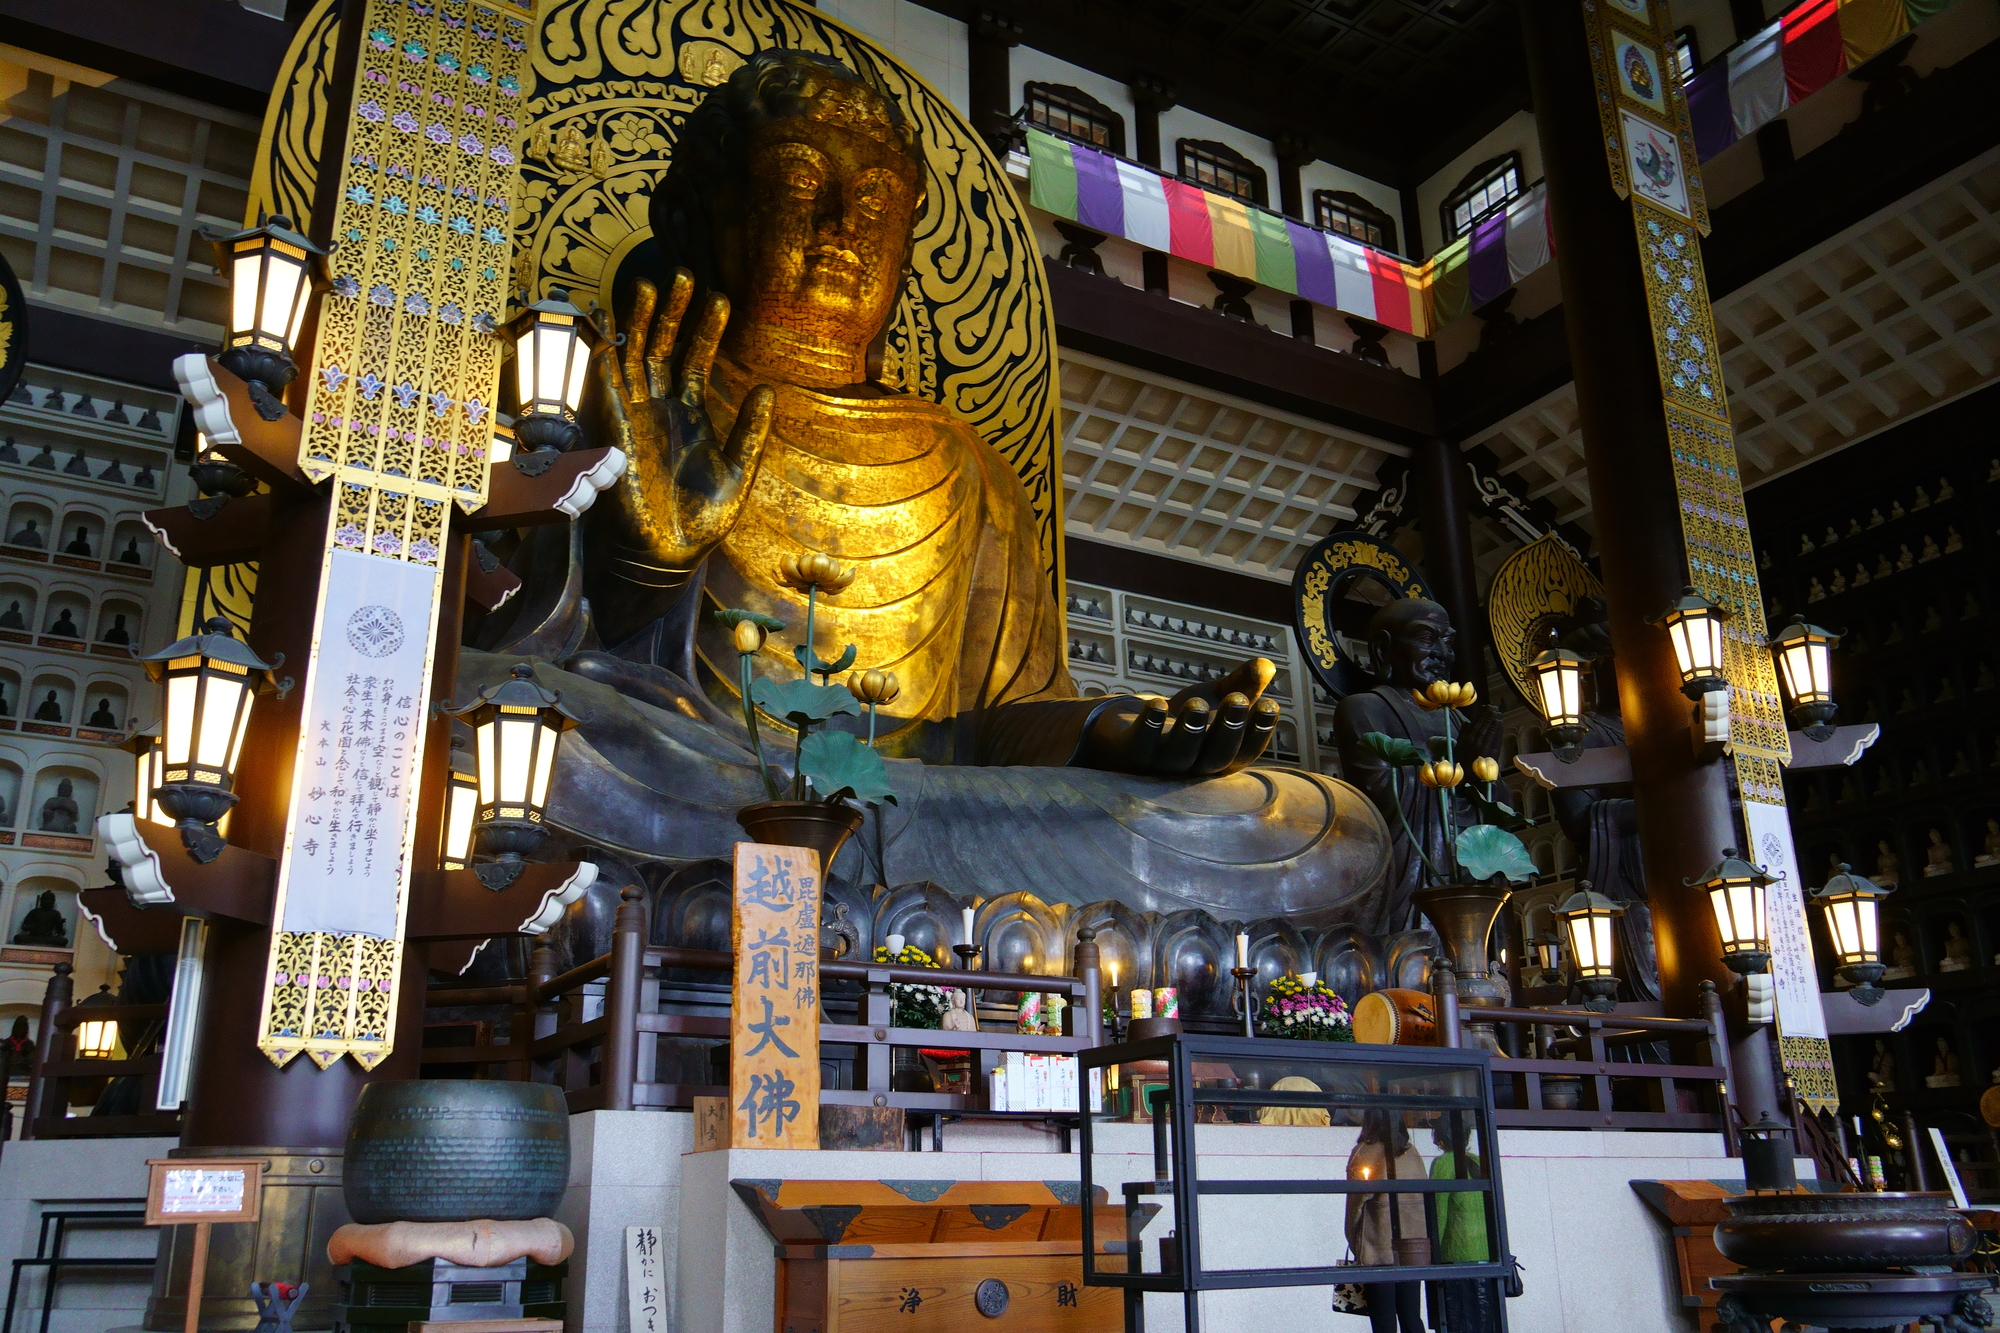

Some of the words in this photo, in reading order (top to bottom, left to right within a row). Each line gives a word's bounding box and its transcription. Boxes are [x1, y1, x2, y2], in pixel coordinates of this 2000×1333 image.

[315, 719, 331, 767] 大本山
[386, 695, 413, 799] 信心のことば
[302, 786, 326, 858] 妙心寺
[737, 854, 801, 1139] 越前大佛
[899, 1287, 923, 1314] 浄
[1057, 1282, 1078, 1308] 財
